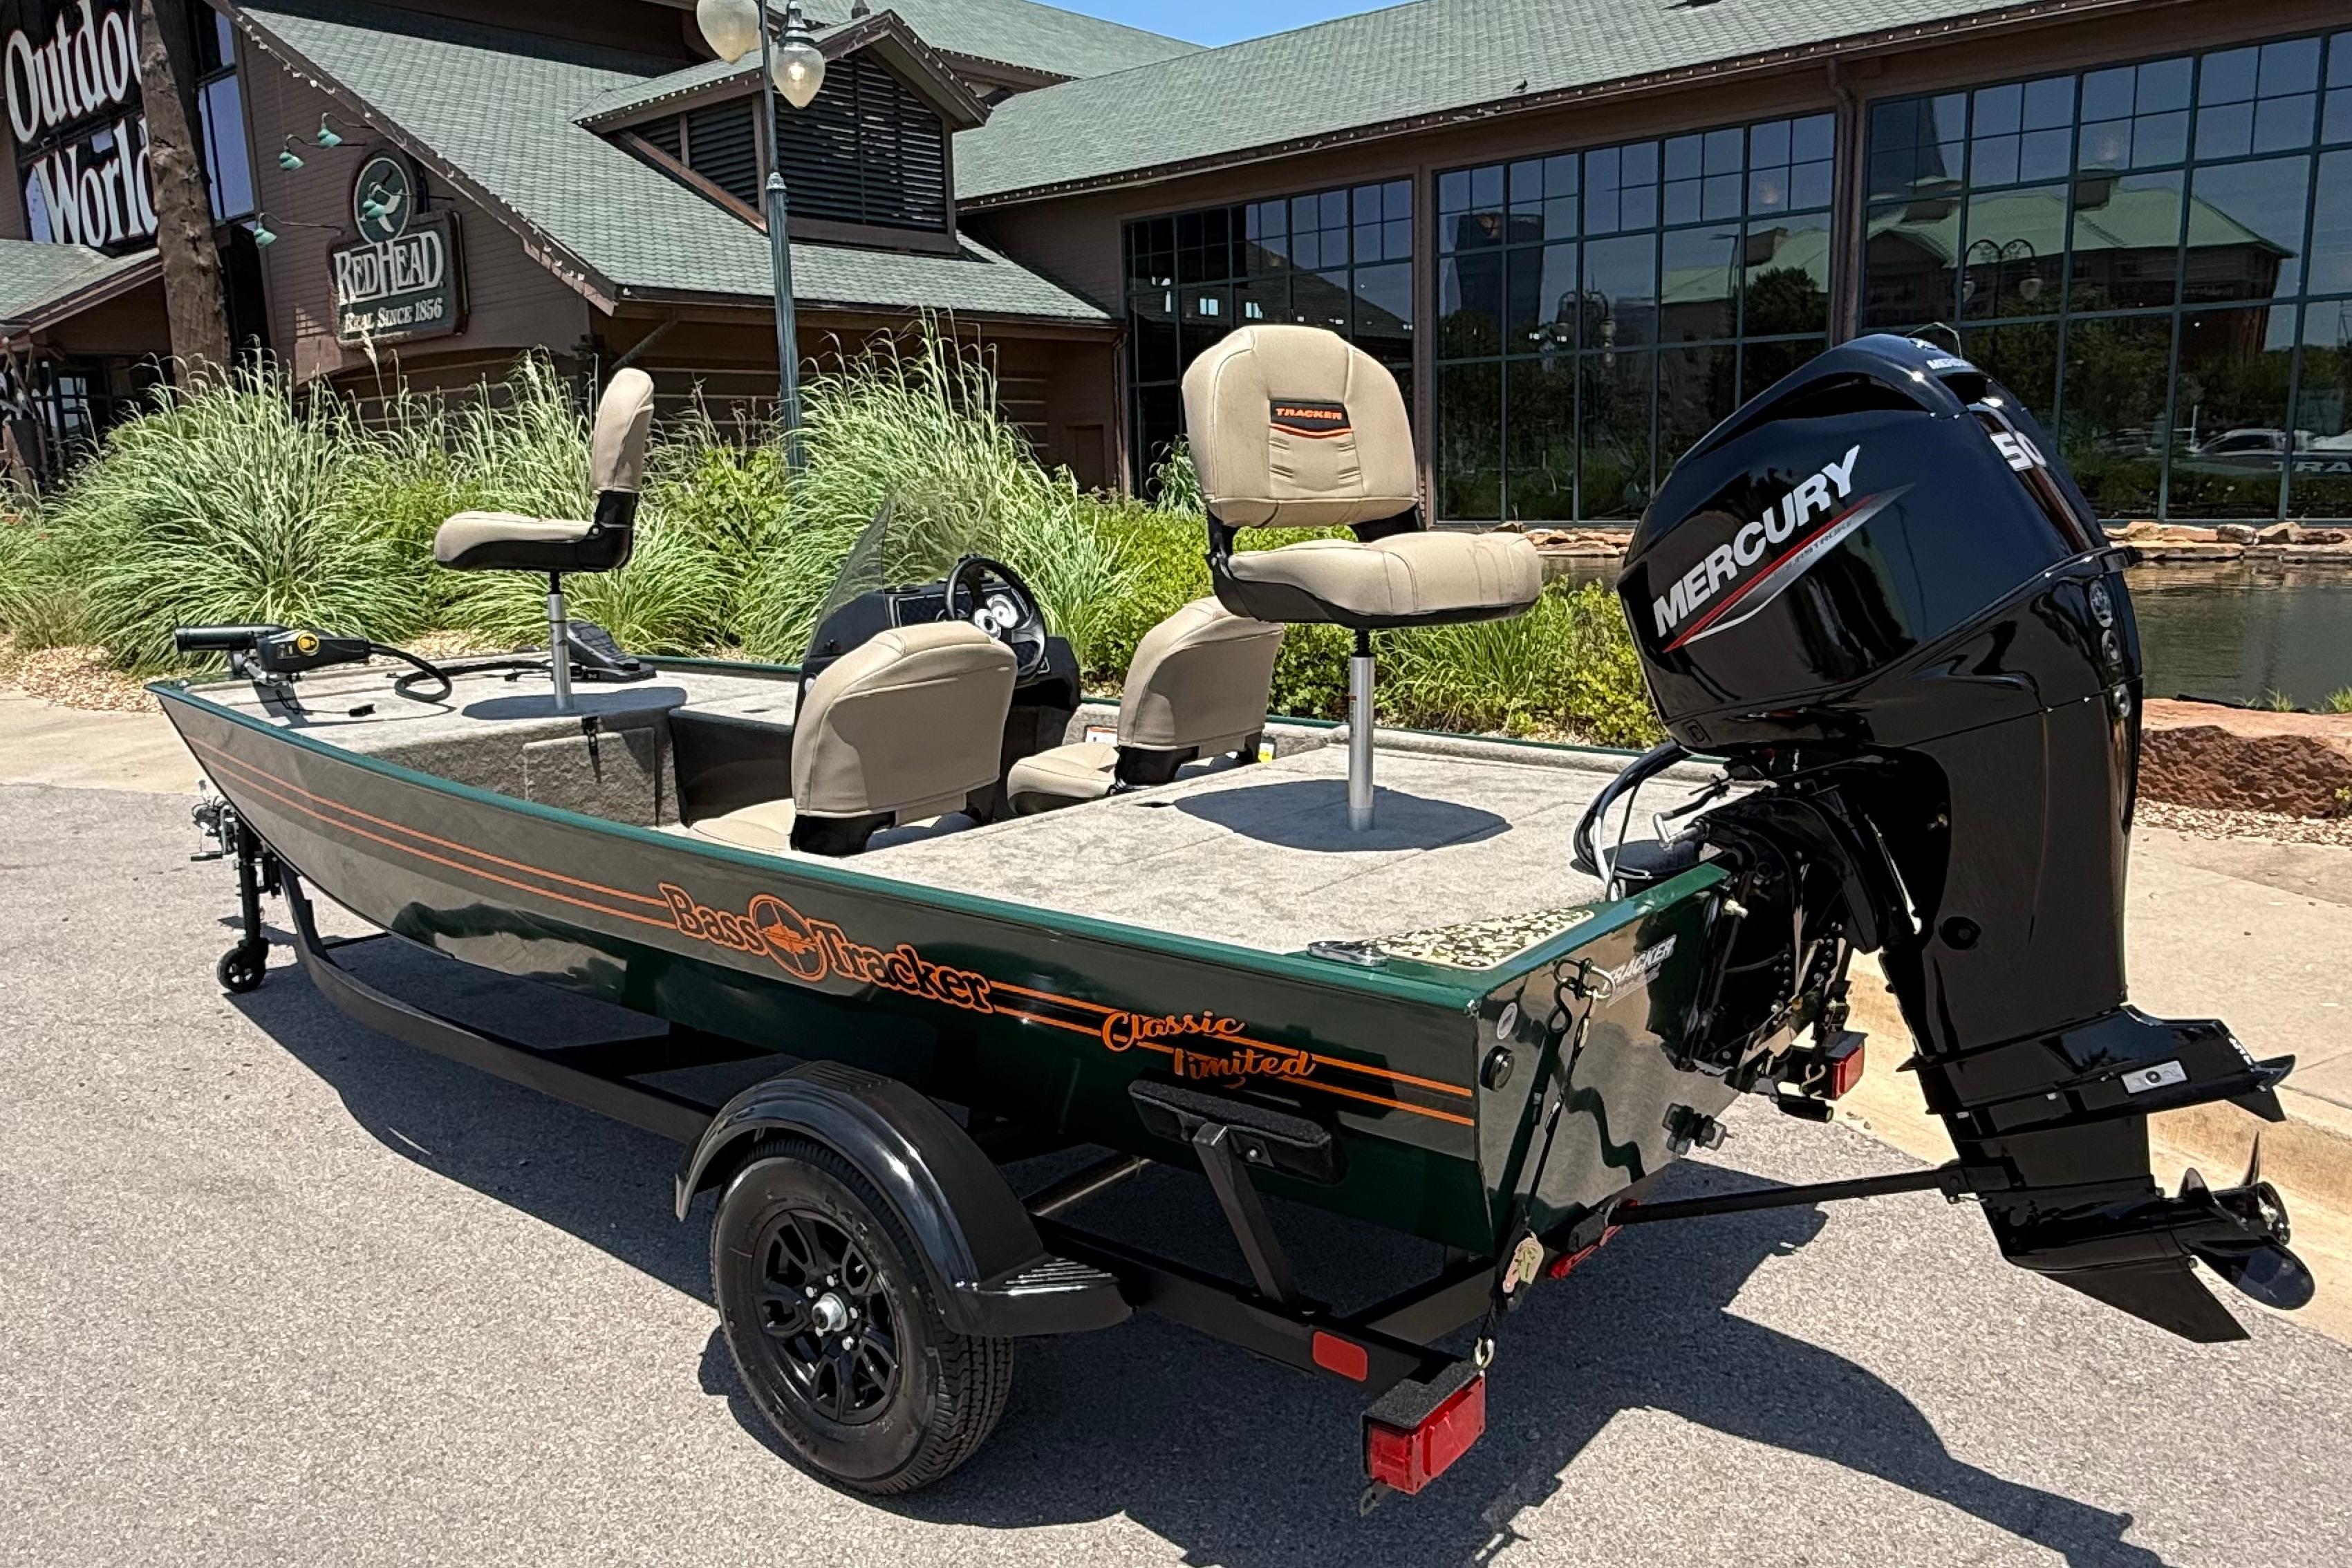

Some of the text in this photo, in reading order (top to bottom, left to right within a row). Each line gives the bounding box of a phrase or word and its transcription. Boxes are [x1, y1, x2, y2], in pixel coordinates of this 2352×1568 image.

[35, 117, 158, 248] World
[377, 307, 413, 328] SINCE
[415, 297, 443, 322] 1856
[1276, 407, 1342, 420] TRACKER
[1990, 431, 2046, 471] 50
[1653, 445, 1860, 637] MERCURY
[658, 882, 993, 1015] Bass Tracker
[1102, 1010, 1245, 1052] Classic
